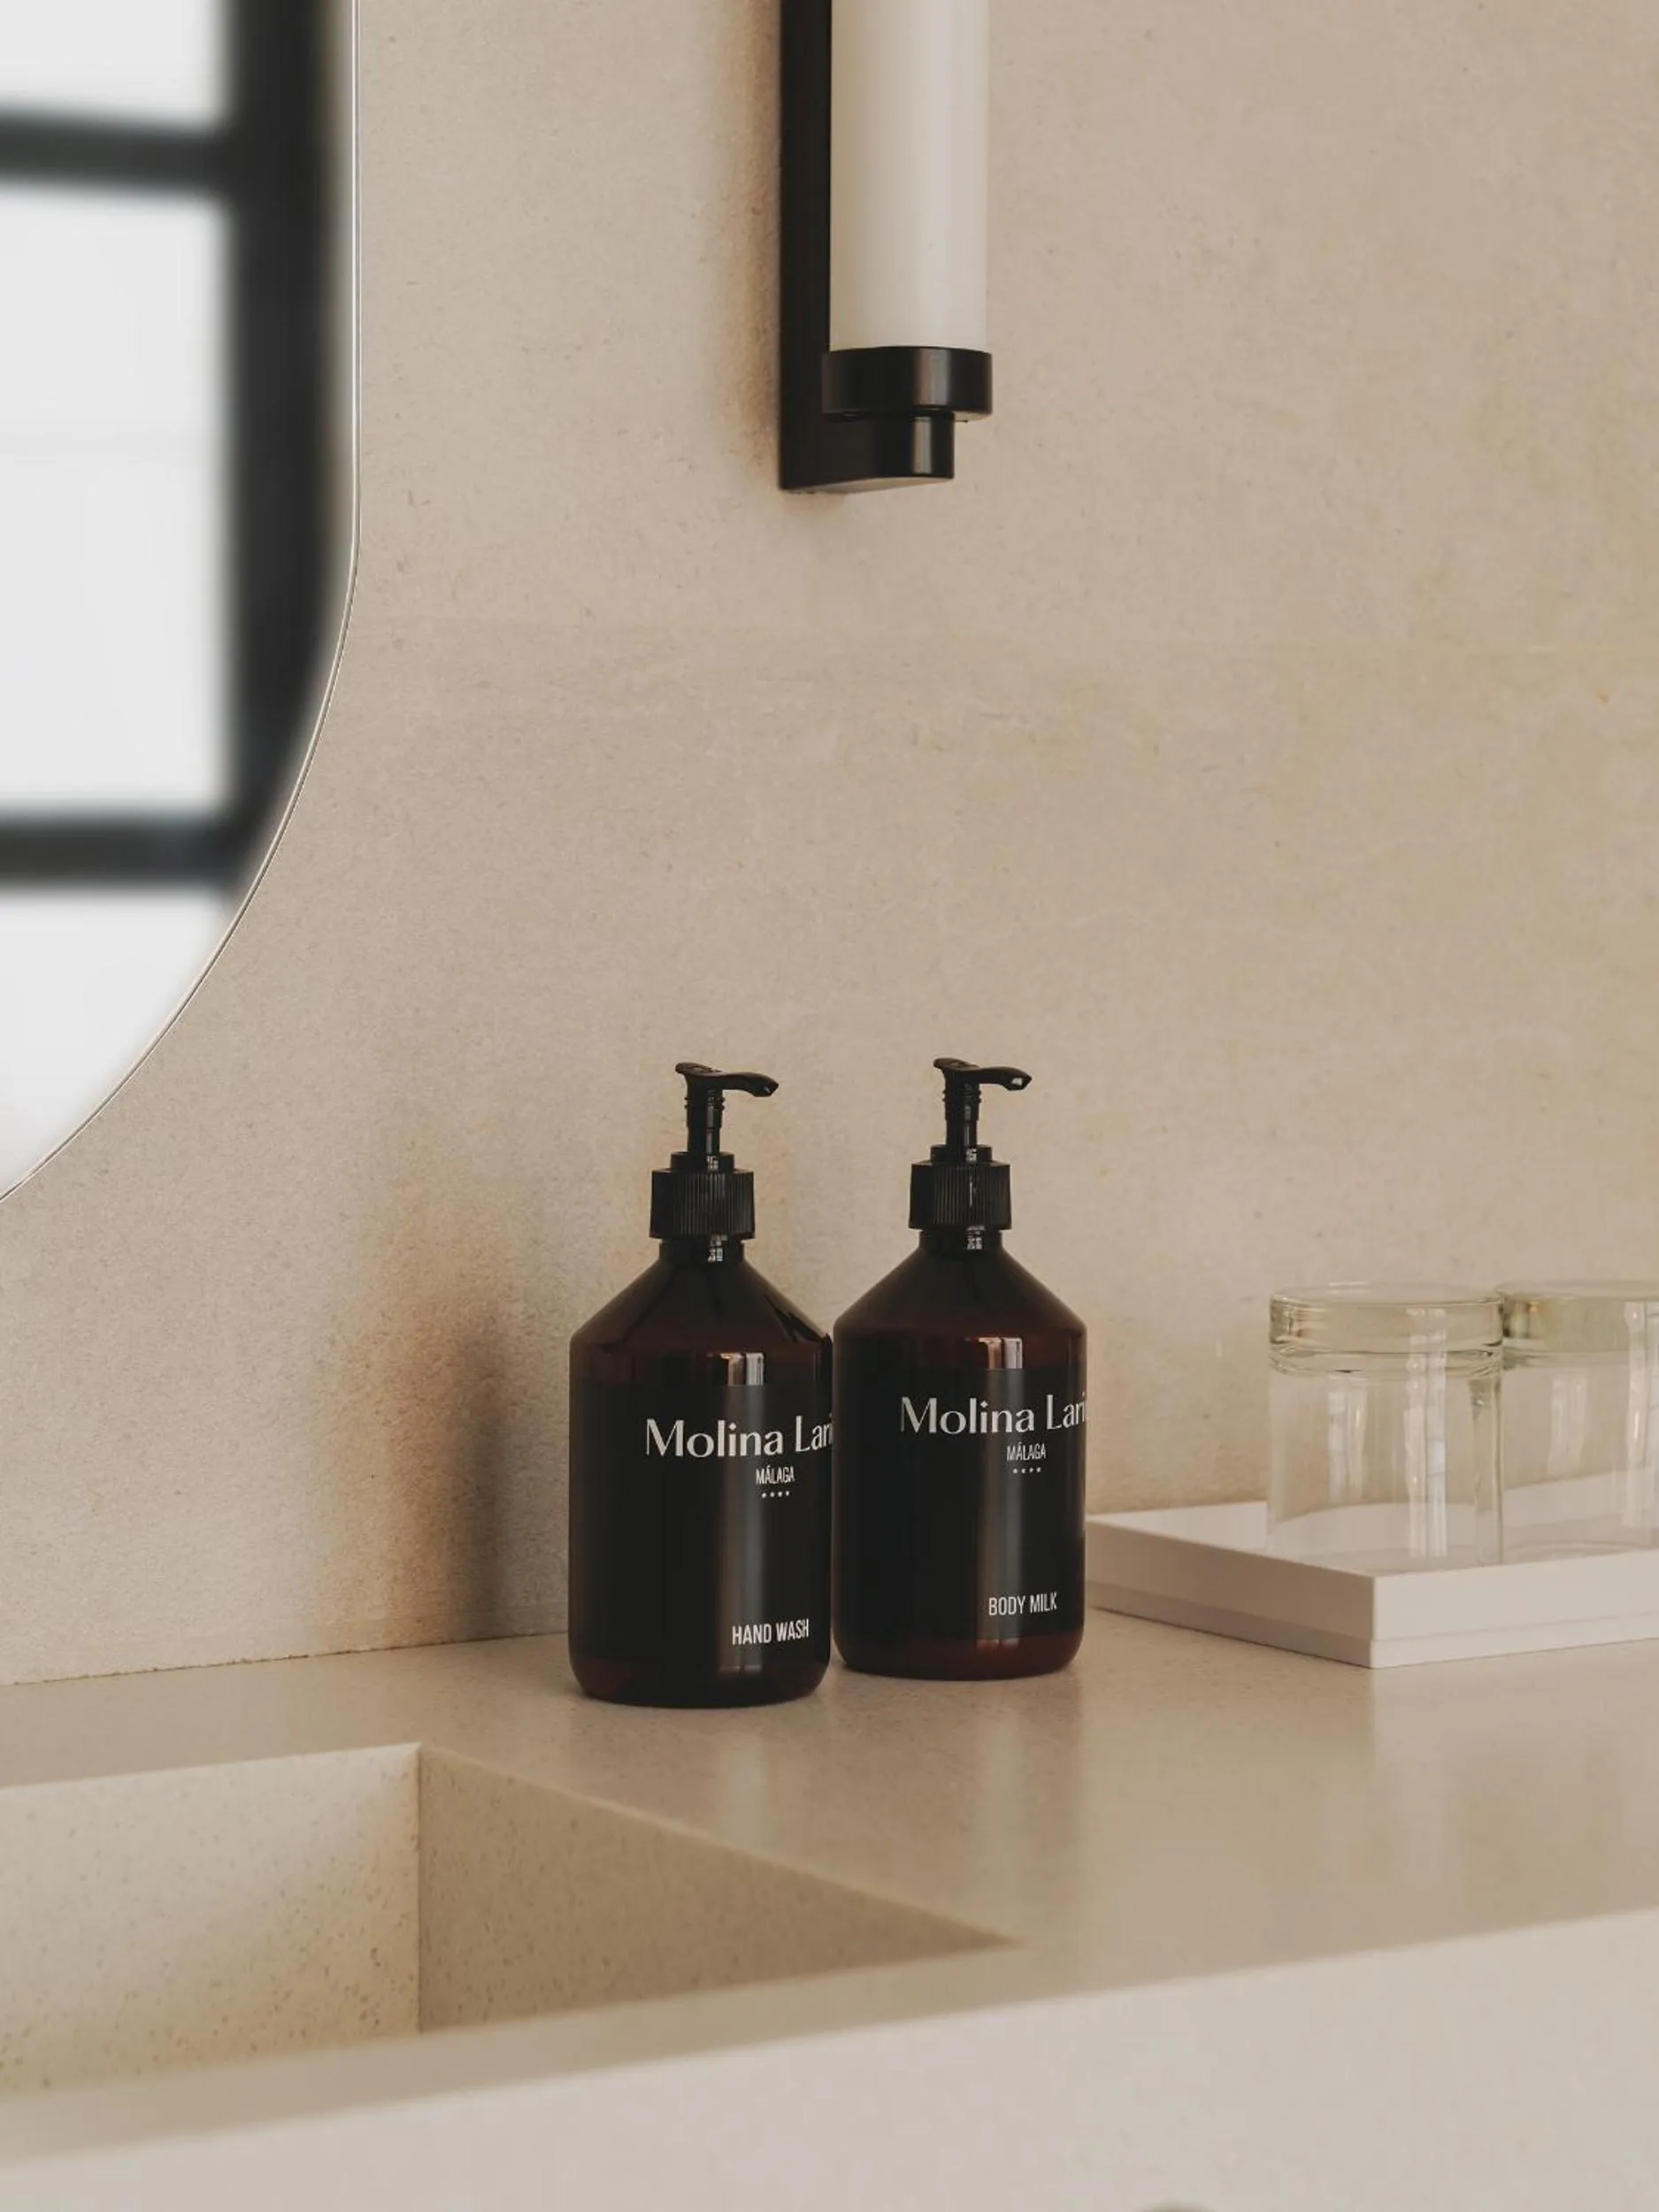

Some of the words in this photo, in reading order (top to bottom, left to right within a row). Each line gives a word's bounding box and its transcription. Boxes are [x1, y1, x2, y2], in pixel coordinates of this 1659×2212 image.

[901, 1395, 1034, 1434] Molina
[645, 1417, 783, 1458] Molina
[1007, 1441, 1047, 1462] MÁLAGA
[756, 1464, 795, 1485] MÁLAGA
[988, 1595, 1025, 1616] BODY
[1030, 1592, 1058, 1612] MILK
[732, 1623, 772, 1646] HAND
[776, 1618, 810, 1641] WASH
